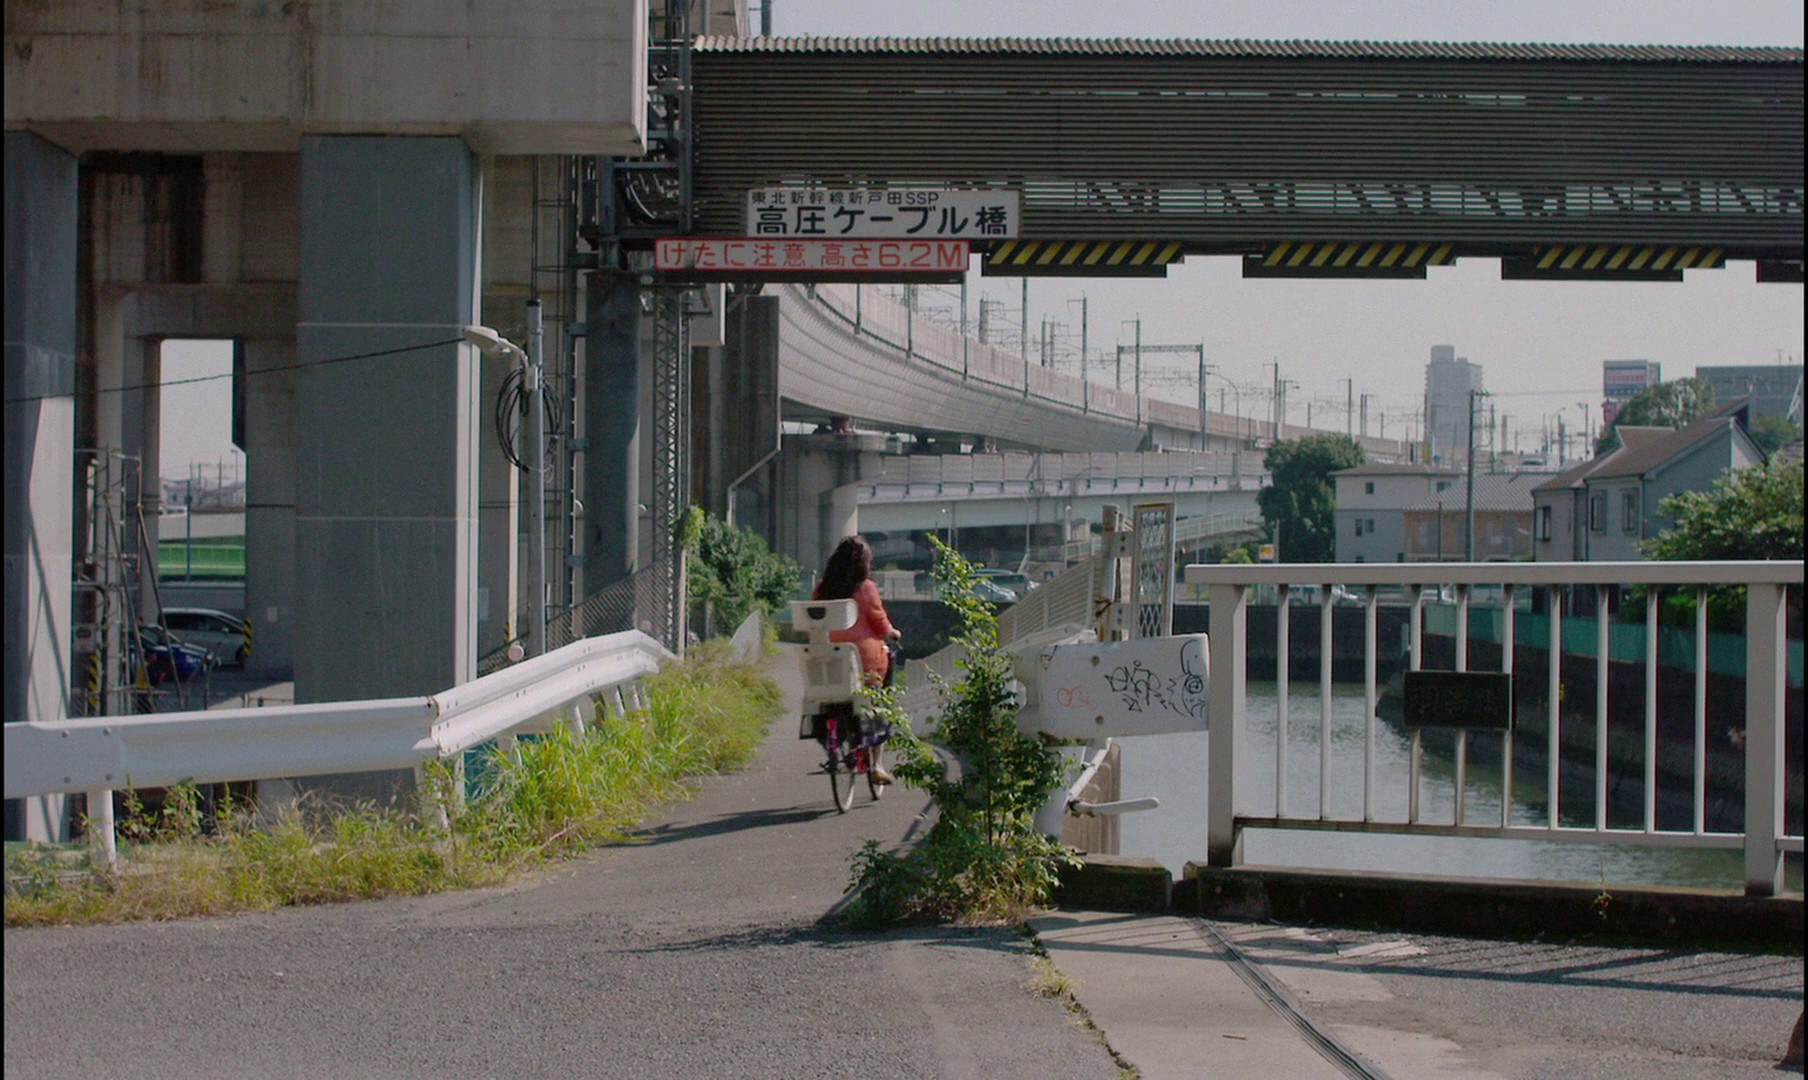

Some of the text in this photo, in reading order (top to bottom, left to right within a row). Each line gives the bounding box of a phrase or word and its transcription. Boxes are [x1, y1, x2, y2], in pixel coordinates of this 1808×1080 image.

[756, 205, 1008, 235] 高圧ケーブル橋
[663, 243, 961, 267] けたに注意 高さ6.2M
